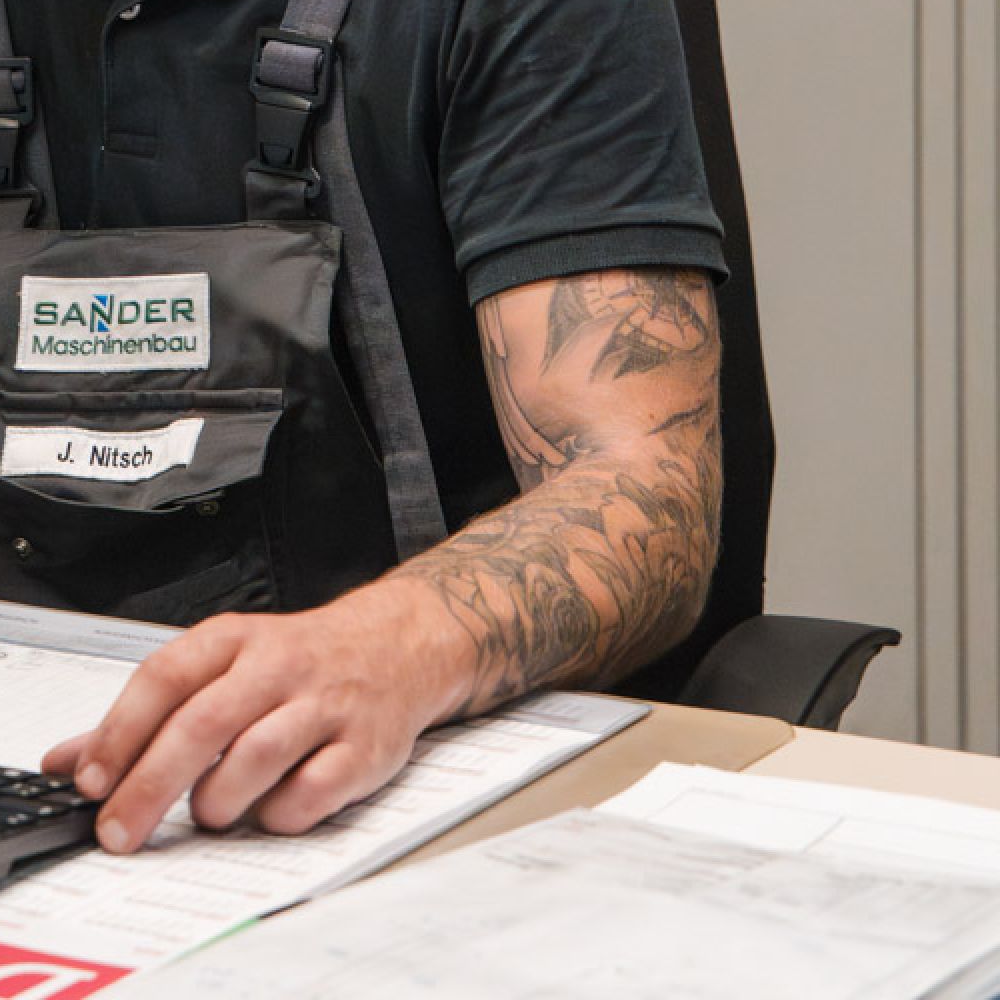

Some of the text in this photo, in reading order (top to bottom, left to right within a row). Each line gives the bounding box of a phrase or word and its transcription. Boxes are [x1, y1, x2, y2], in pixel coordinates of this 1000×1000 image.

[34, 294, 195, 333] SANDER
[32, 334, 197, 356] Maschinenbau
[57, 441, 153, 469] J. Nitsch
